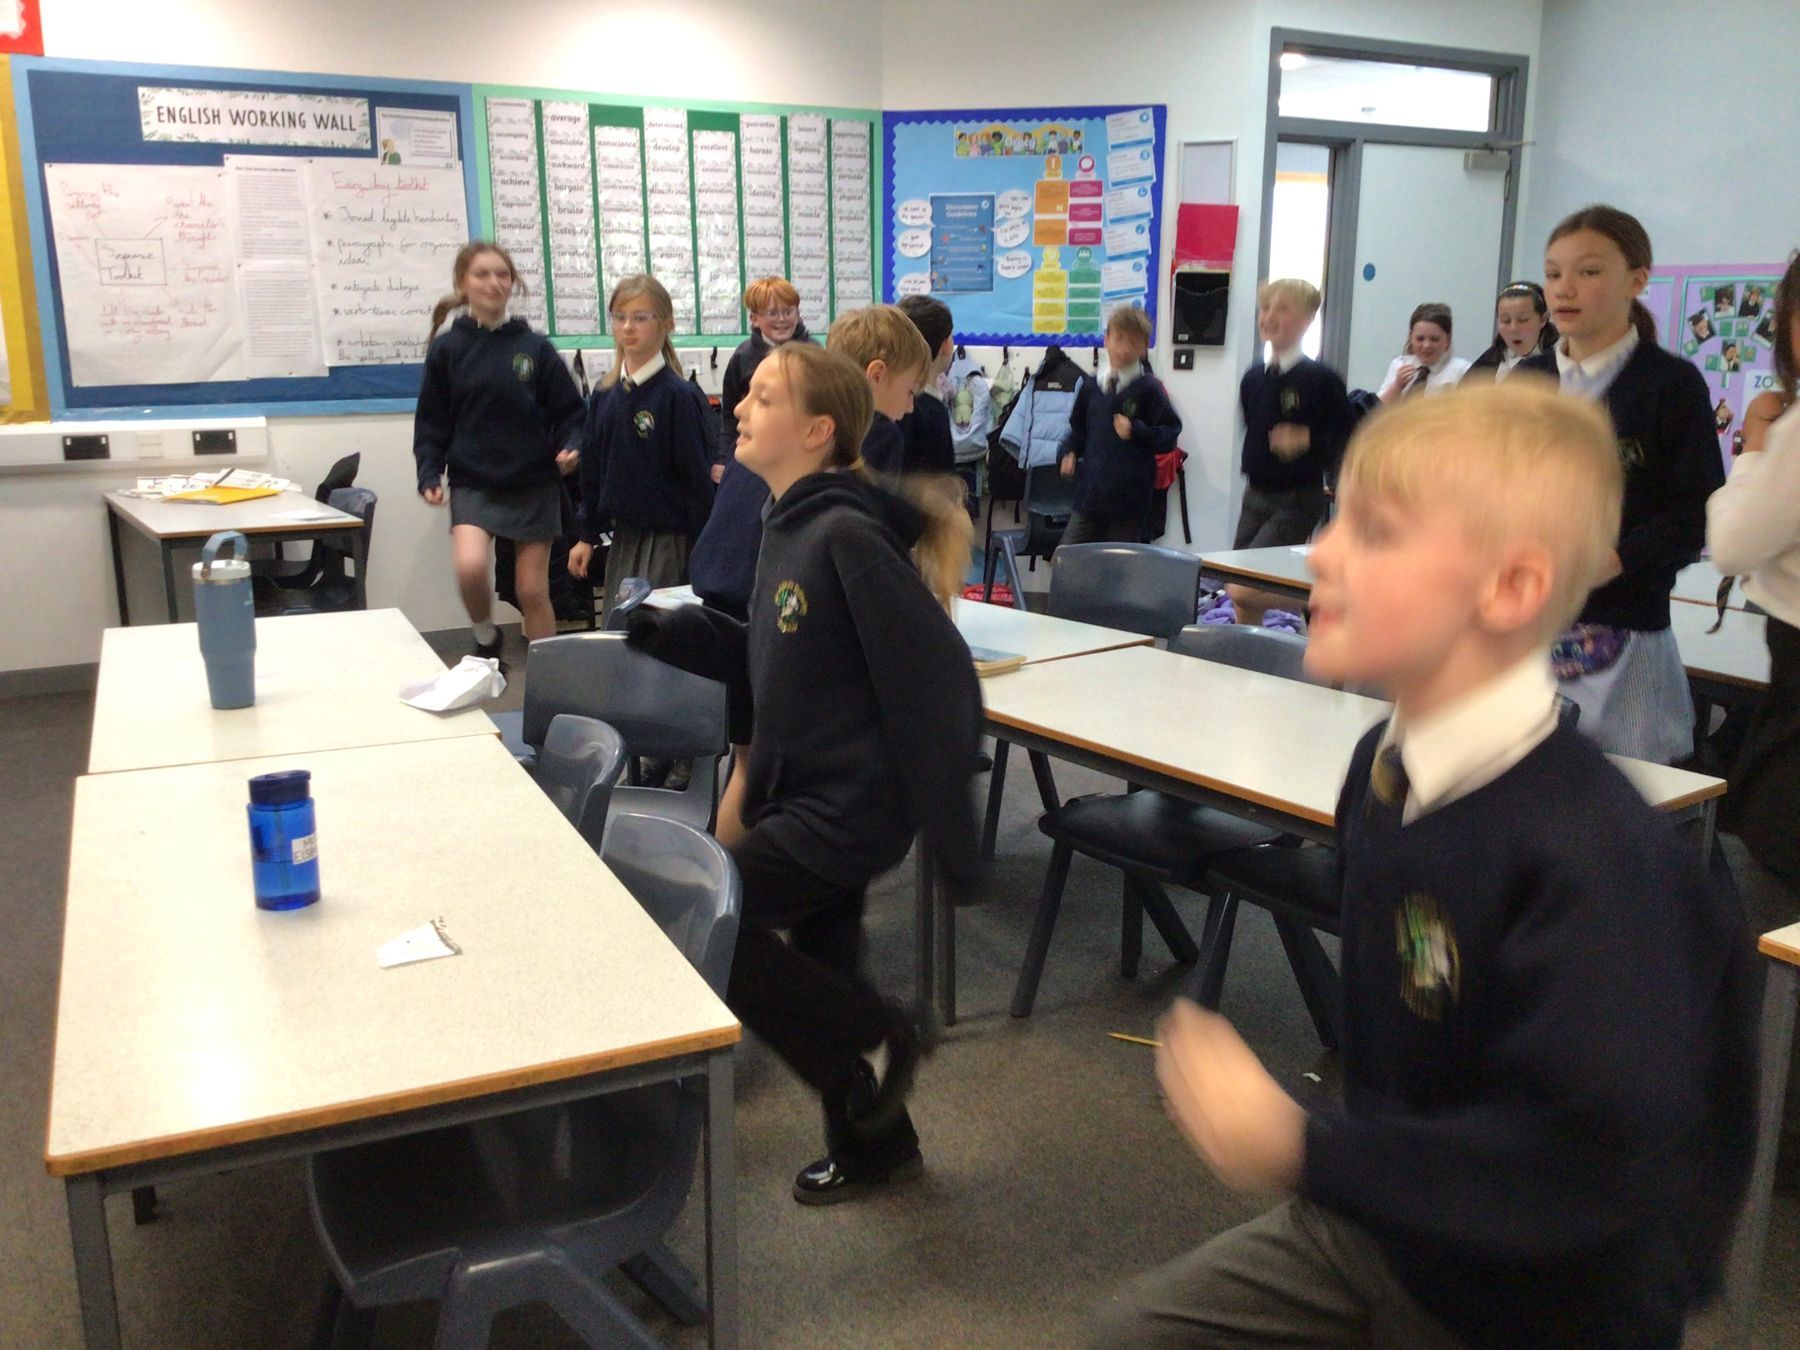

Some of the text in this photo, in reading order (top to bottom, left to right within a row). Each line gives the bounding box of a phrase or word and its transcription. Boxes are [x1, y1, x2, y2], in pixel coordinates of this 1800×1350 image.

[156, 105, 222, 125] ENGLISH
[228, 108, 307, 129] WORKING
[312, 112, 357, 132] WALL
[550, 114, 581, 124] average
[648, 121, 684, 129] determined
[550, 138, 584, 146] available
[700, 143, 728, 151] excellent
[653, 142, 681, 153] develop
[749, 146, 773, 155] harass
[794, 145, 821, 155] lightning
[551, 161, 586, 170] awkward
[500, 177, 531, 186] achieve
[554, 183, 585, 193] bargain
[749, 189, 776, 199] identity
[557, 205, 585, 215] bruise
[797, 210, 820, 219] muscle
[501, 222, 535, 231] amateur
[400, 237, 417, 253] for
[101, 259, 144, 281] Toolkit
[1753, 375, 1775, 389] ZO
